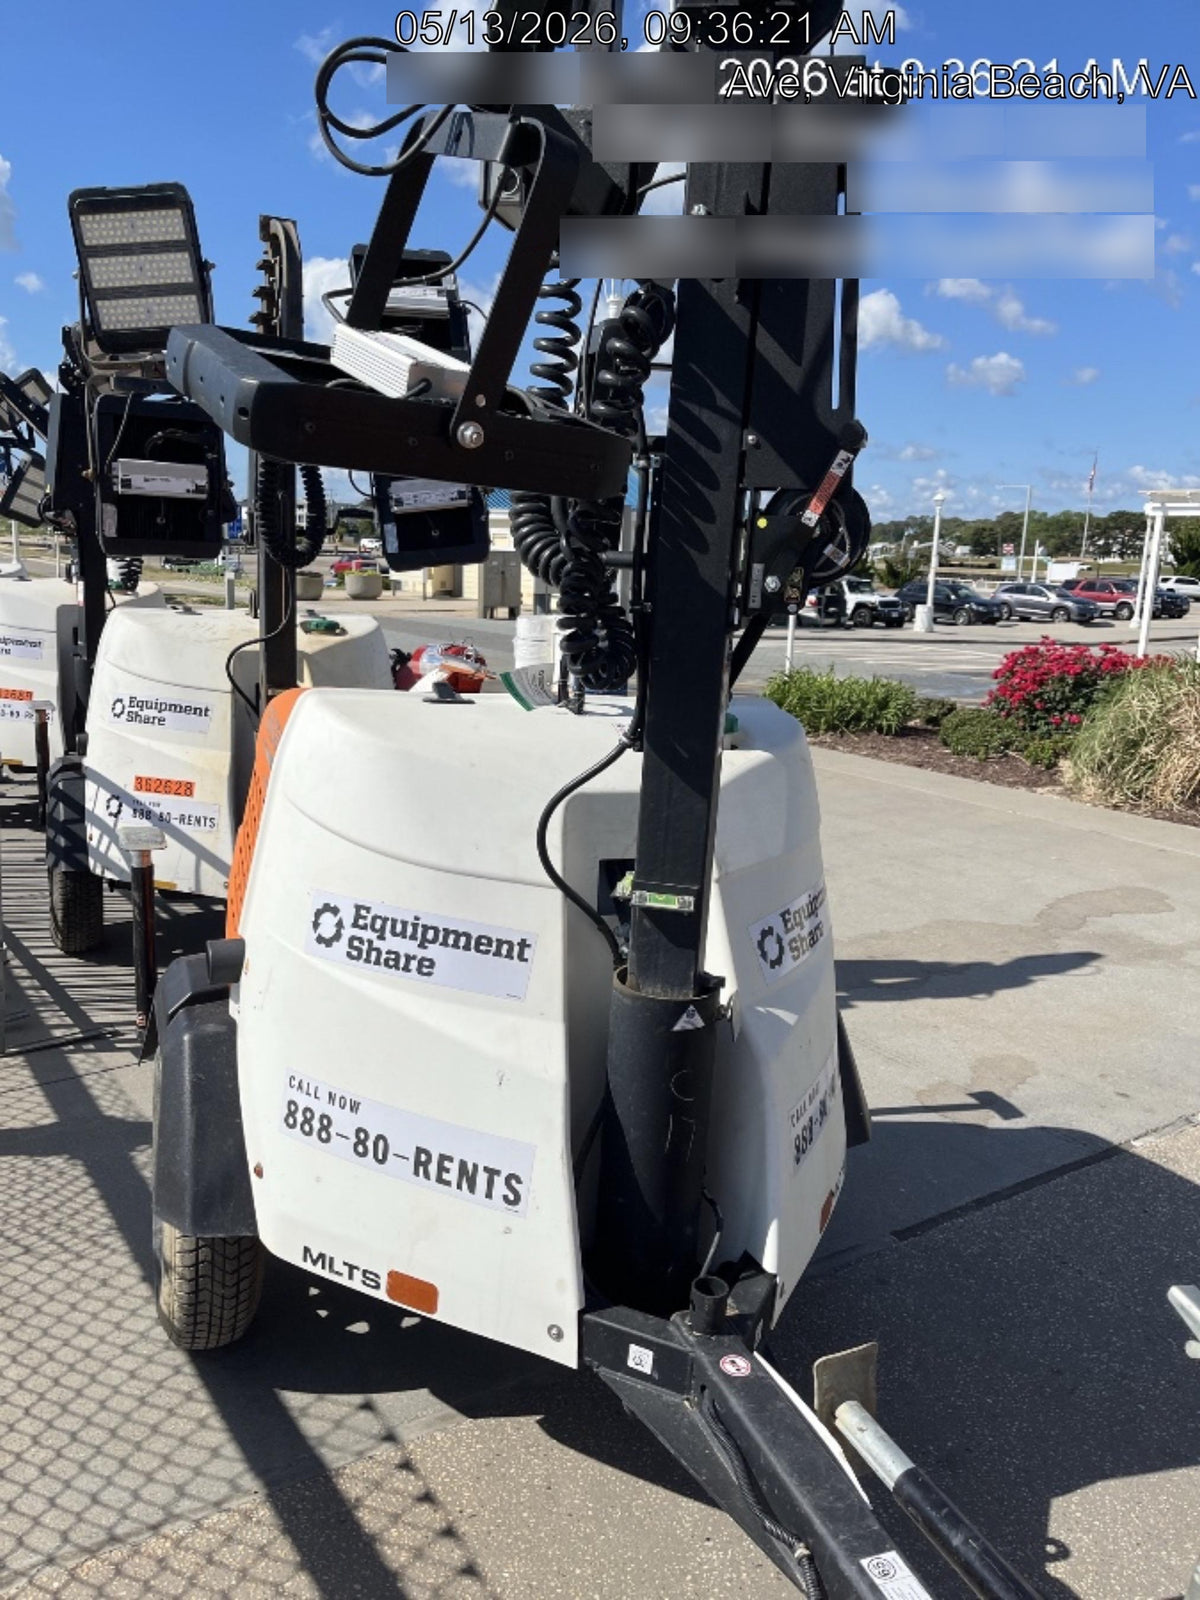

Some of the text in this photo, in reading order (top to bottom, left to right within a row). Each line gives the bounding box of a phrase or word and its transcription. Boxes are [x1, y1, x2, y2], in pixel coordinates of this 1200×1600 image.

[126, 710, 166, 726] Share
[128, 696, 210, 717] Equipment
[351, 903, 532, 963] Equipment
[346, 935, 436, 977] Share
[289, 1075, 362, 1116] CALL NOW
[284, 1099, 524, 1207] 888-80-RENTS
[303, 1245, 382, 1291] MLTS
